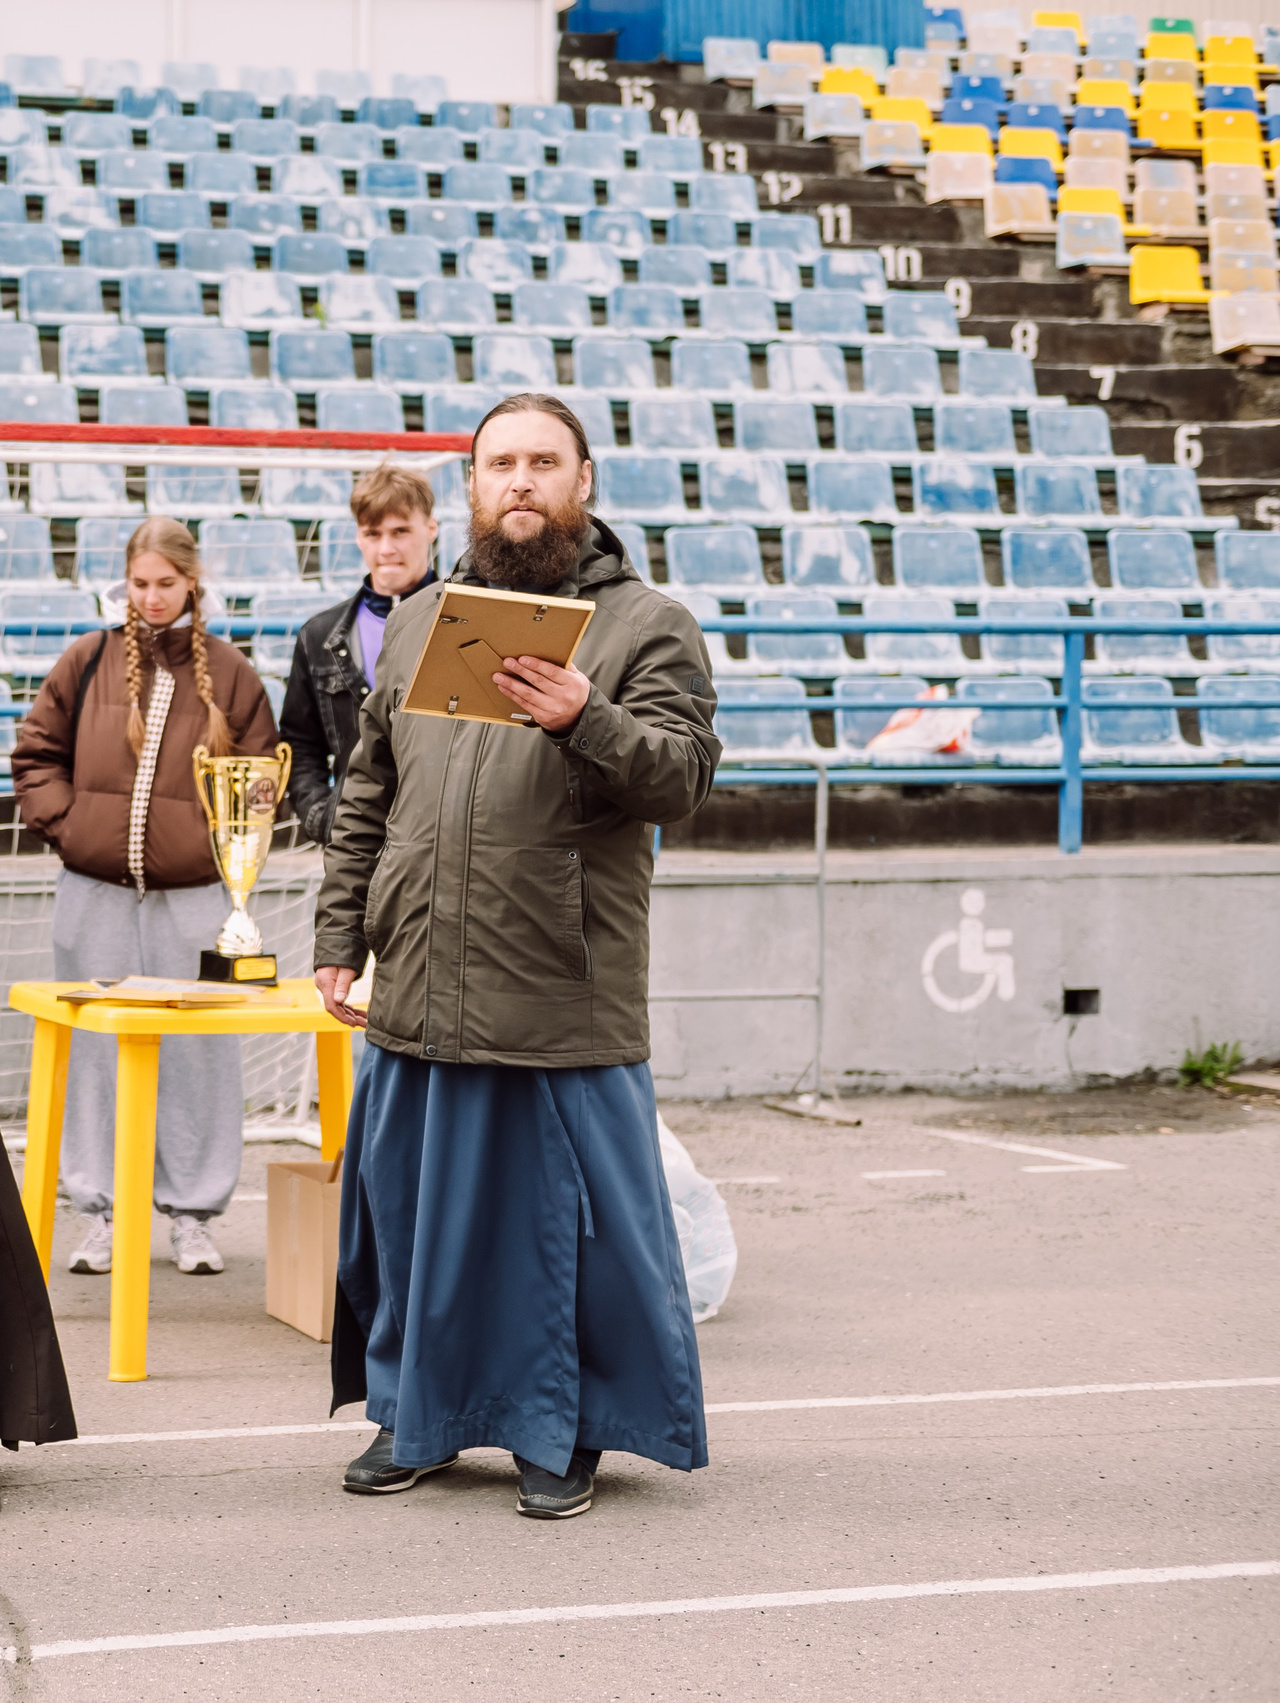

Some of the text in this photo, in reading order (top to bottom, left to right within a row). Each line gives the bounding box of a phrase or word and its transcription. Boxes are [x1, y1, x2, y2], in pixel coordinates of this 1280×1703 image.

[616, 76, 655, 111] 15
[660, 107, 701, 140] 14
[708, 141, 748, 173] 13
[762, 171, 803, 204] 12
[817, 204, 852, 243] 11
[879, 244, 922, 281] 10
[944, 277, 972, 318] 9
[1011, 320, 1039, 360] 8
[1089, 366, 1116, 400] 7
[1174, 424, 1204, 469] 6
